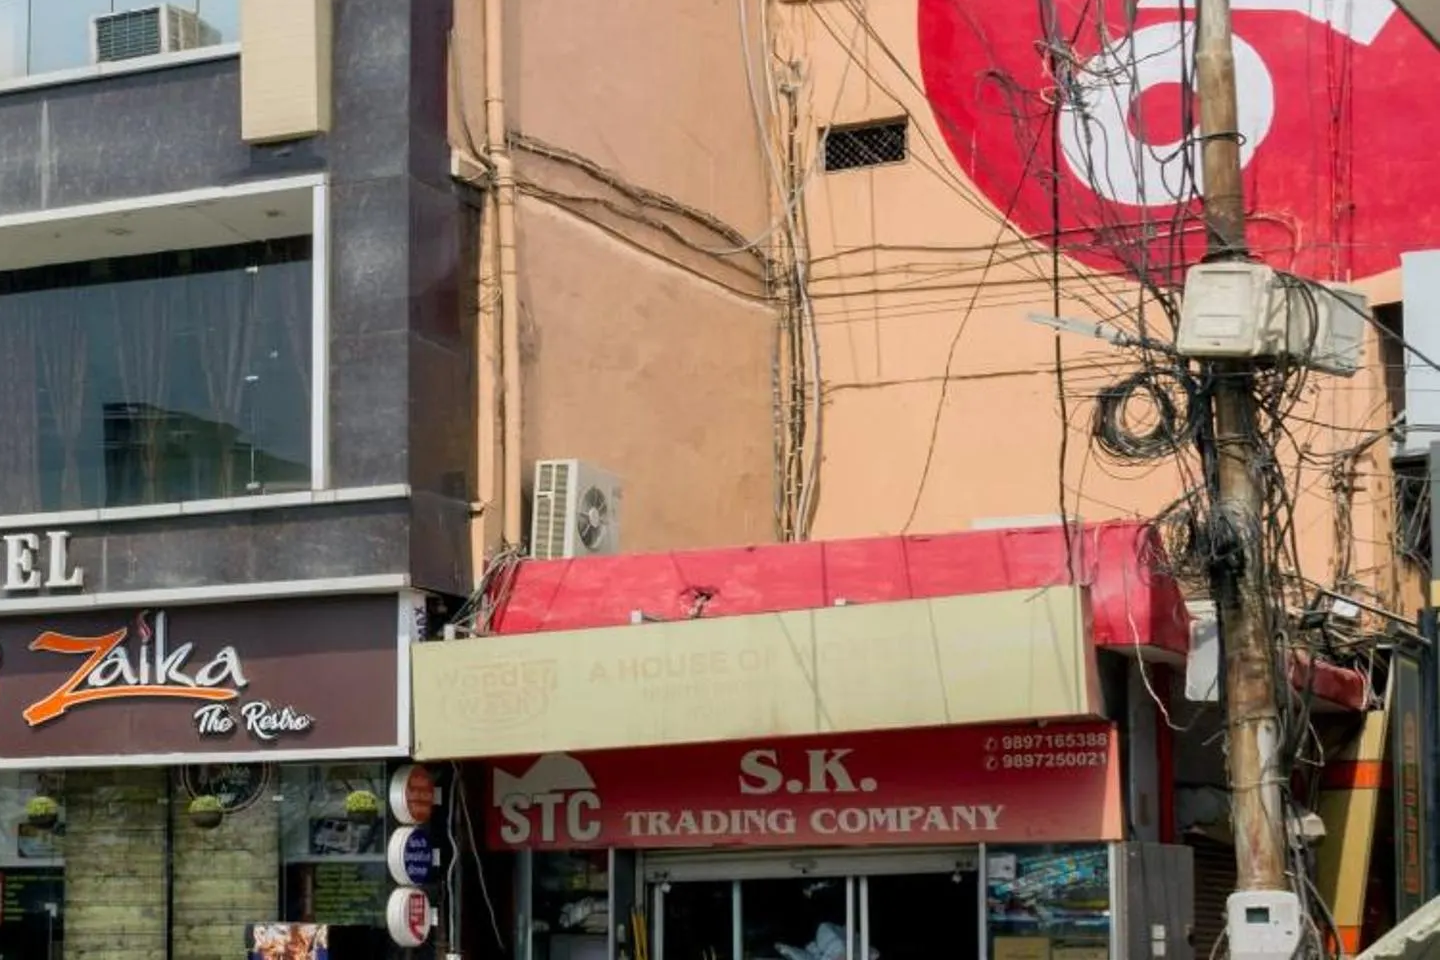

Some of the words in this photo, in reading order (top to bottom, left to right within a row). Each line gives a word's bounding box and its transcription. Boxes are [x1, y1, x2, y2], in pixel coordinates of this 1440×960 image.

[22, 610, 250, 728] Zaika
[193, 702, 237, 735] The
[739, 747, 878, 795] S.K.
[500, 790, 602, 843] STC
[624, 807, 797, 837] TRADING
[810, 803, 1004, 835] COMPANY
